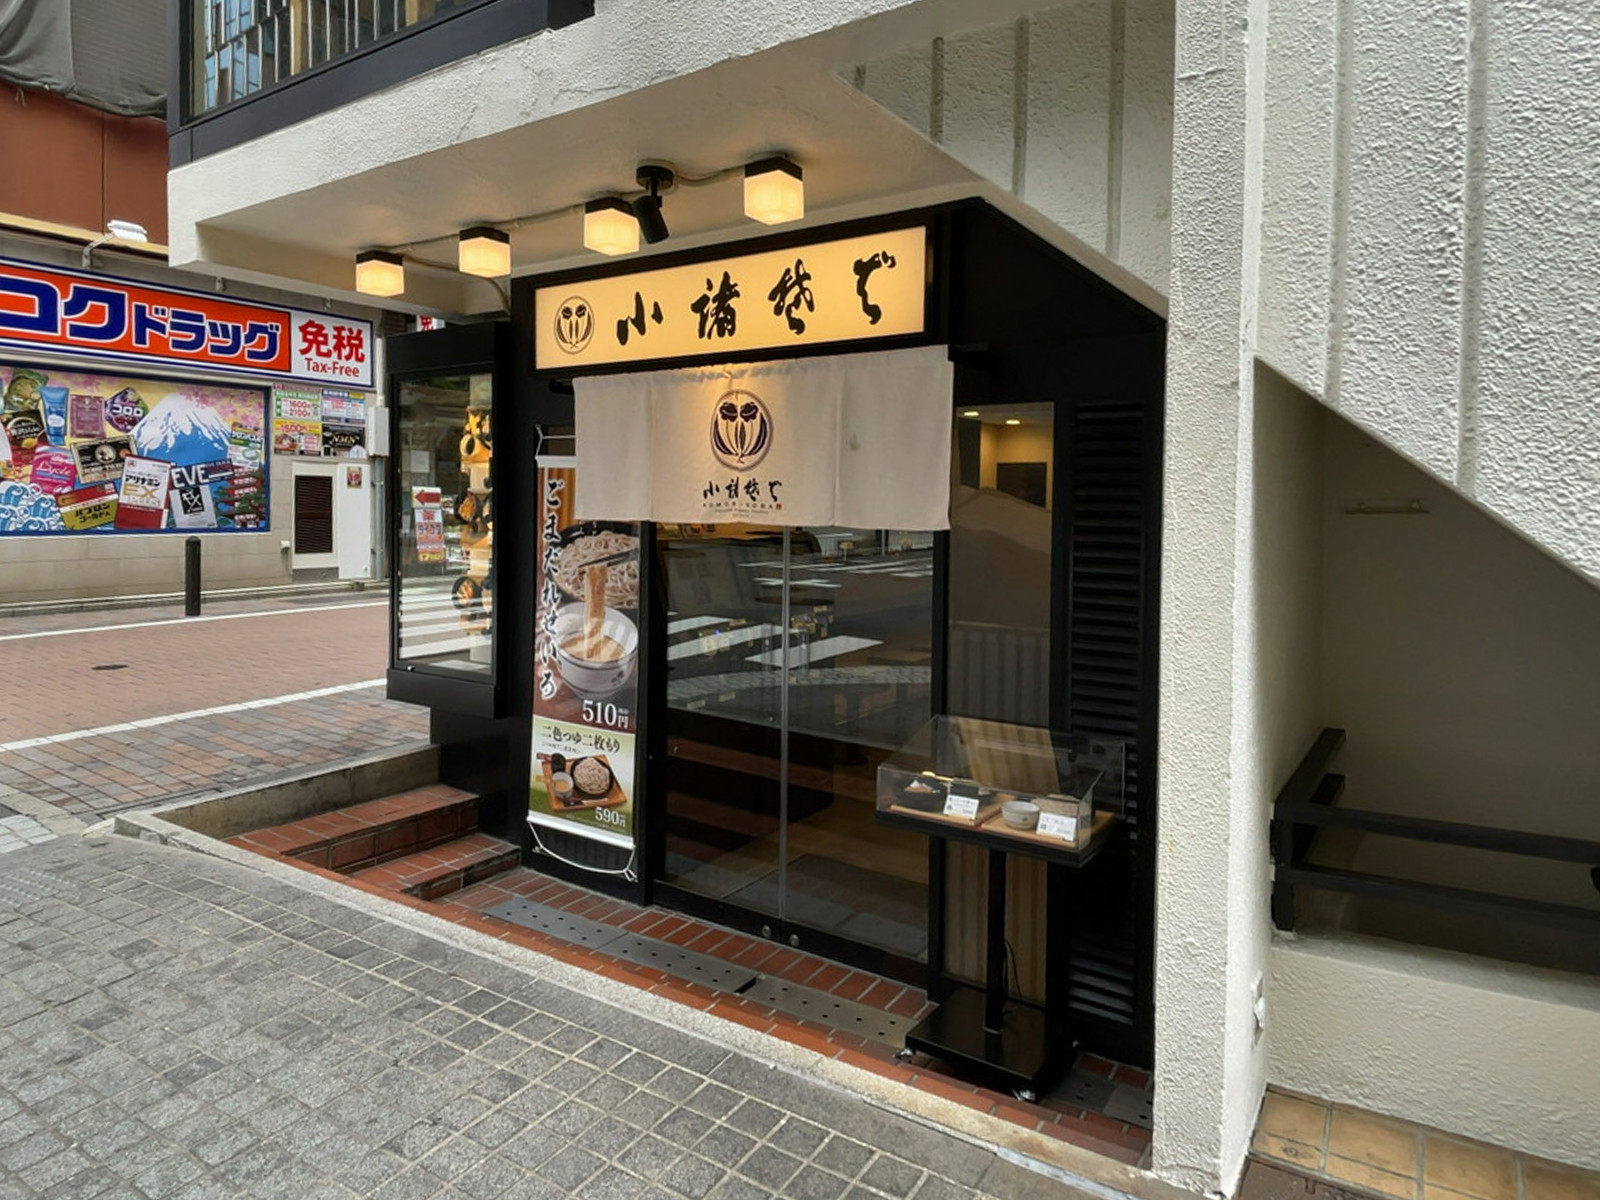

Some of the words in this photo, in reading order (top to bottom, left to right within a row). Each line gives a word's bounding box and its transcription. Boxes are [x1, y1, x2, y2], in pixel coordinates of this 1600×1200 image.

[0, 274, 281, 363] コクドラッグ
[298, 320, 366, 363] 免税
[304, 357, 360, 378] Tax-Free
[111, 403, 143, 418] コロロ
[125, 474, 161, 487] アリナミン
[171, 464, 210, 488] EVE
[123, 483, 160, 498] EX
[75, 502, 110, 517] パブロン
[539, 479, 565, 700] ごまだれせいろ
[541, 725, 621, 753] 二色つゆ二枚もり
